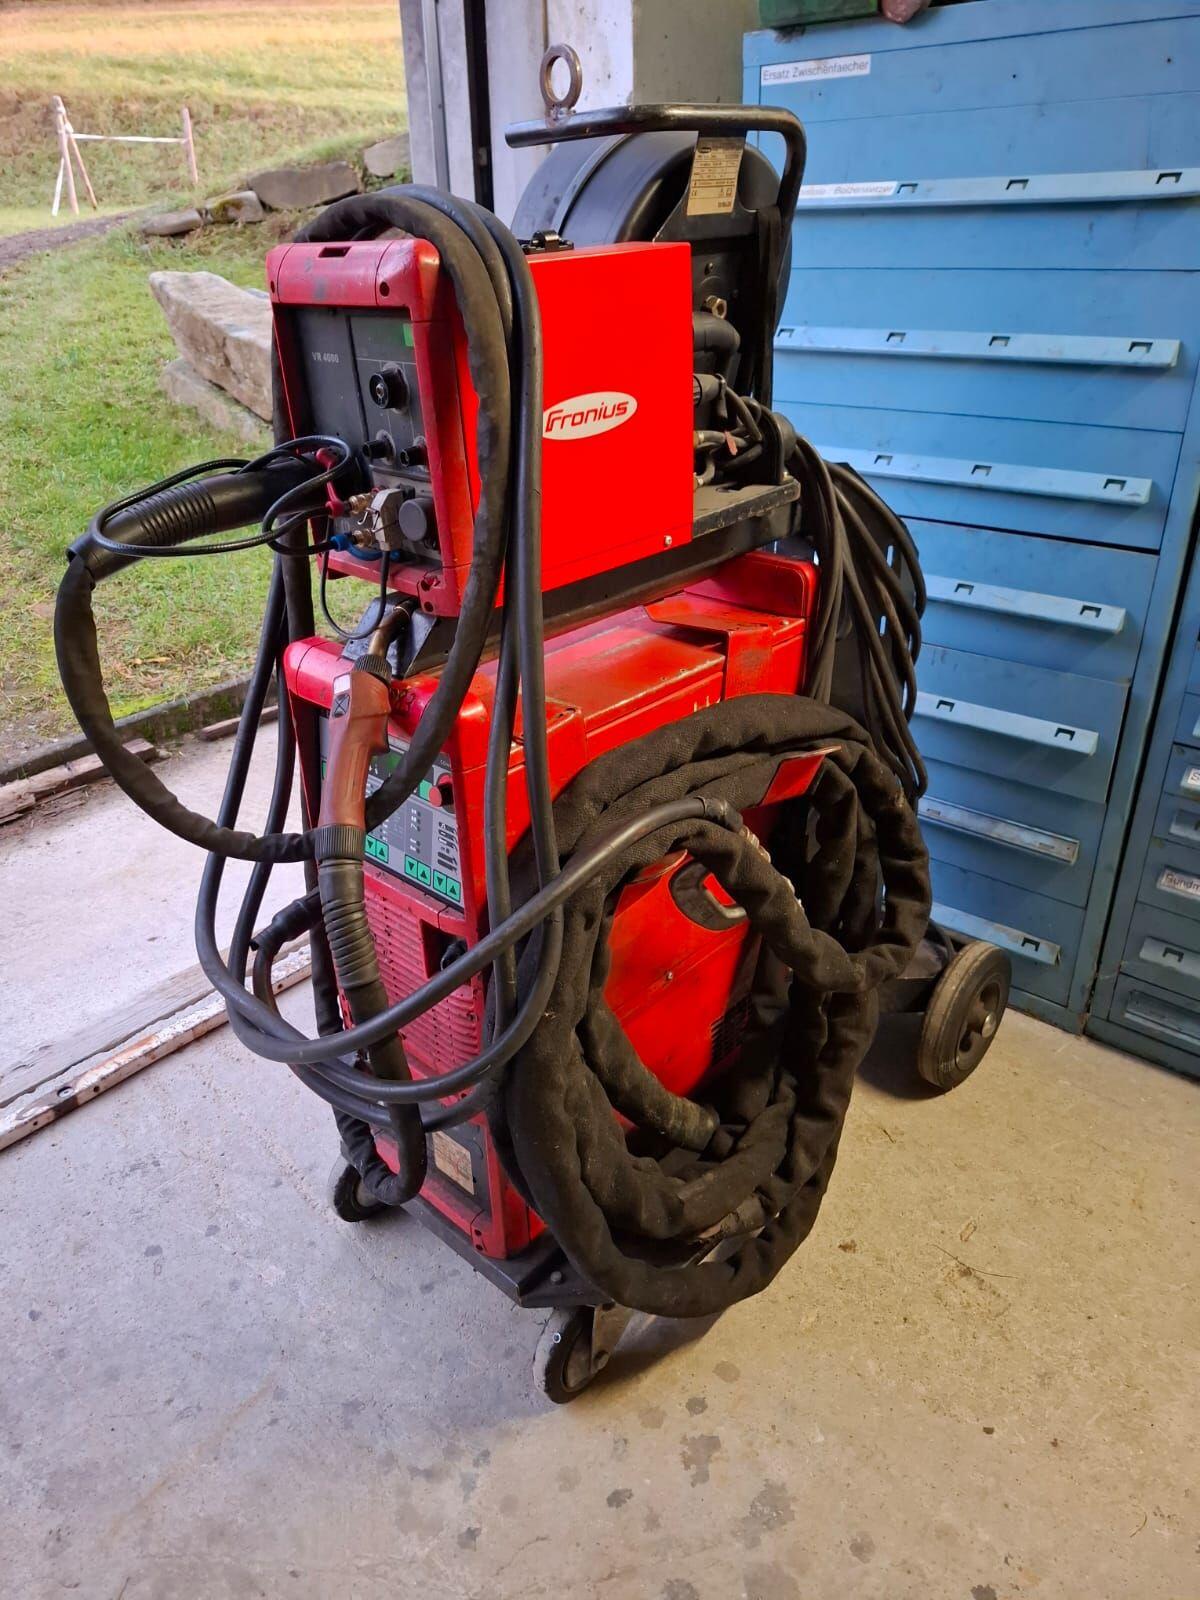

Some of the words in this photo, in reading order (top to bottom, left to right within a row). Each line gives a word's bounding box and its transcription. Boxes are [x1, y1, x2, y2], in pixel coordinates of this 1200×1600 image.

[762, 70, 790, 81] Ersatz
[792, 60, 869, 78] Zwischenfaecher
[312, 352, 322, 361] VR
[323, 353, 339, 363] 4000
[545, 401, 629, 432] Fronius
